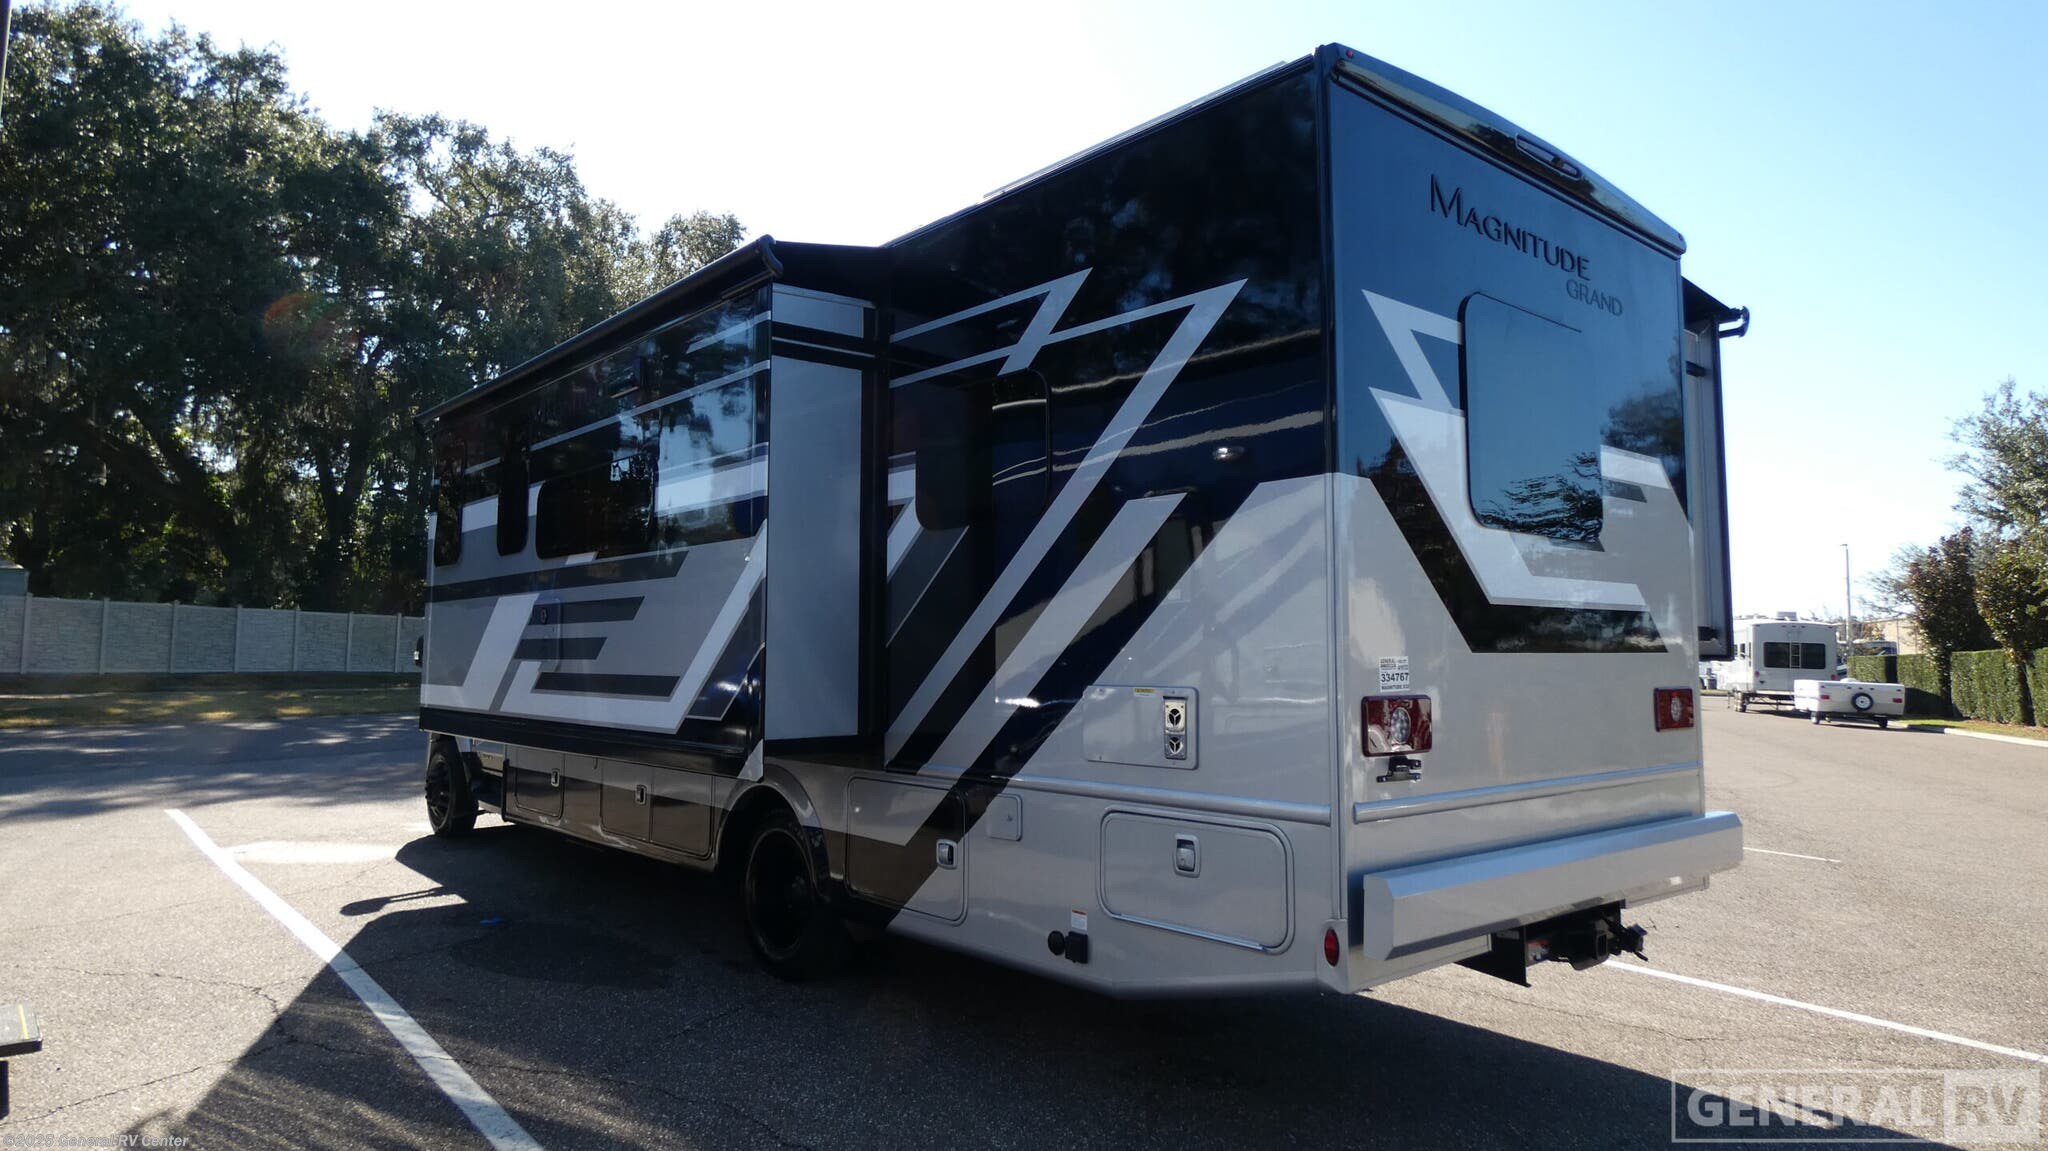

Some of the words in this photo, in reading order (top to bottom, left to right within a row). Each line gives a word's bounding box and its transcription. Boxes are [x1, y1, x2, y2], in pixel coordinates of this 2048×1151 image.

[1430, 173, 1590, 281] MAGNITUDE
[1565, 279, 1624, 317] GRAND
[1380, 672, 1409, 683] 334767
